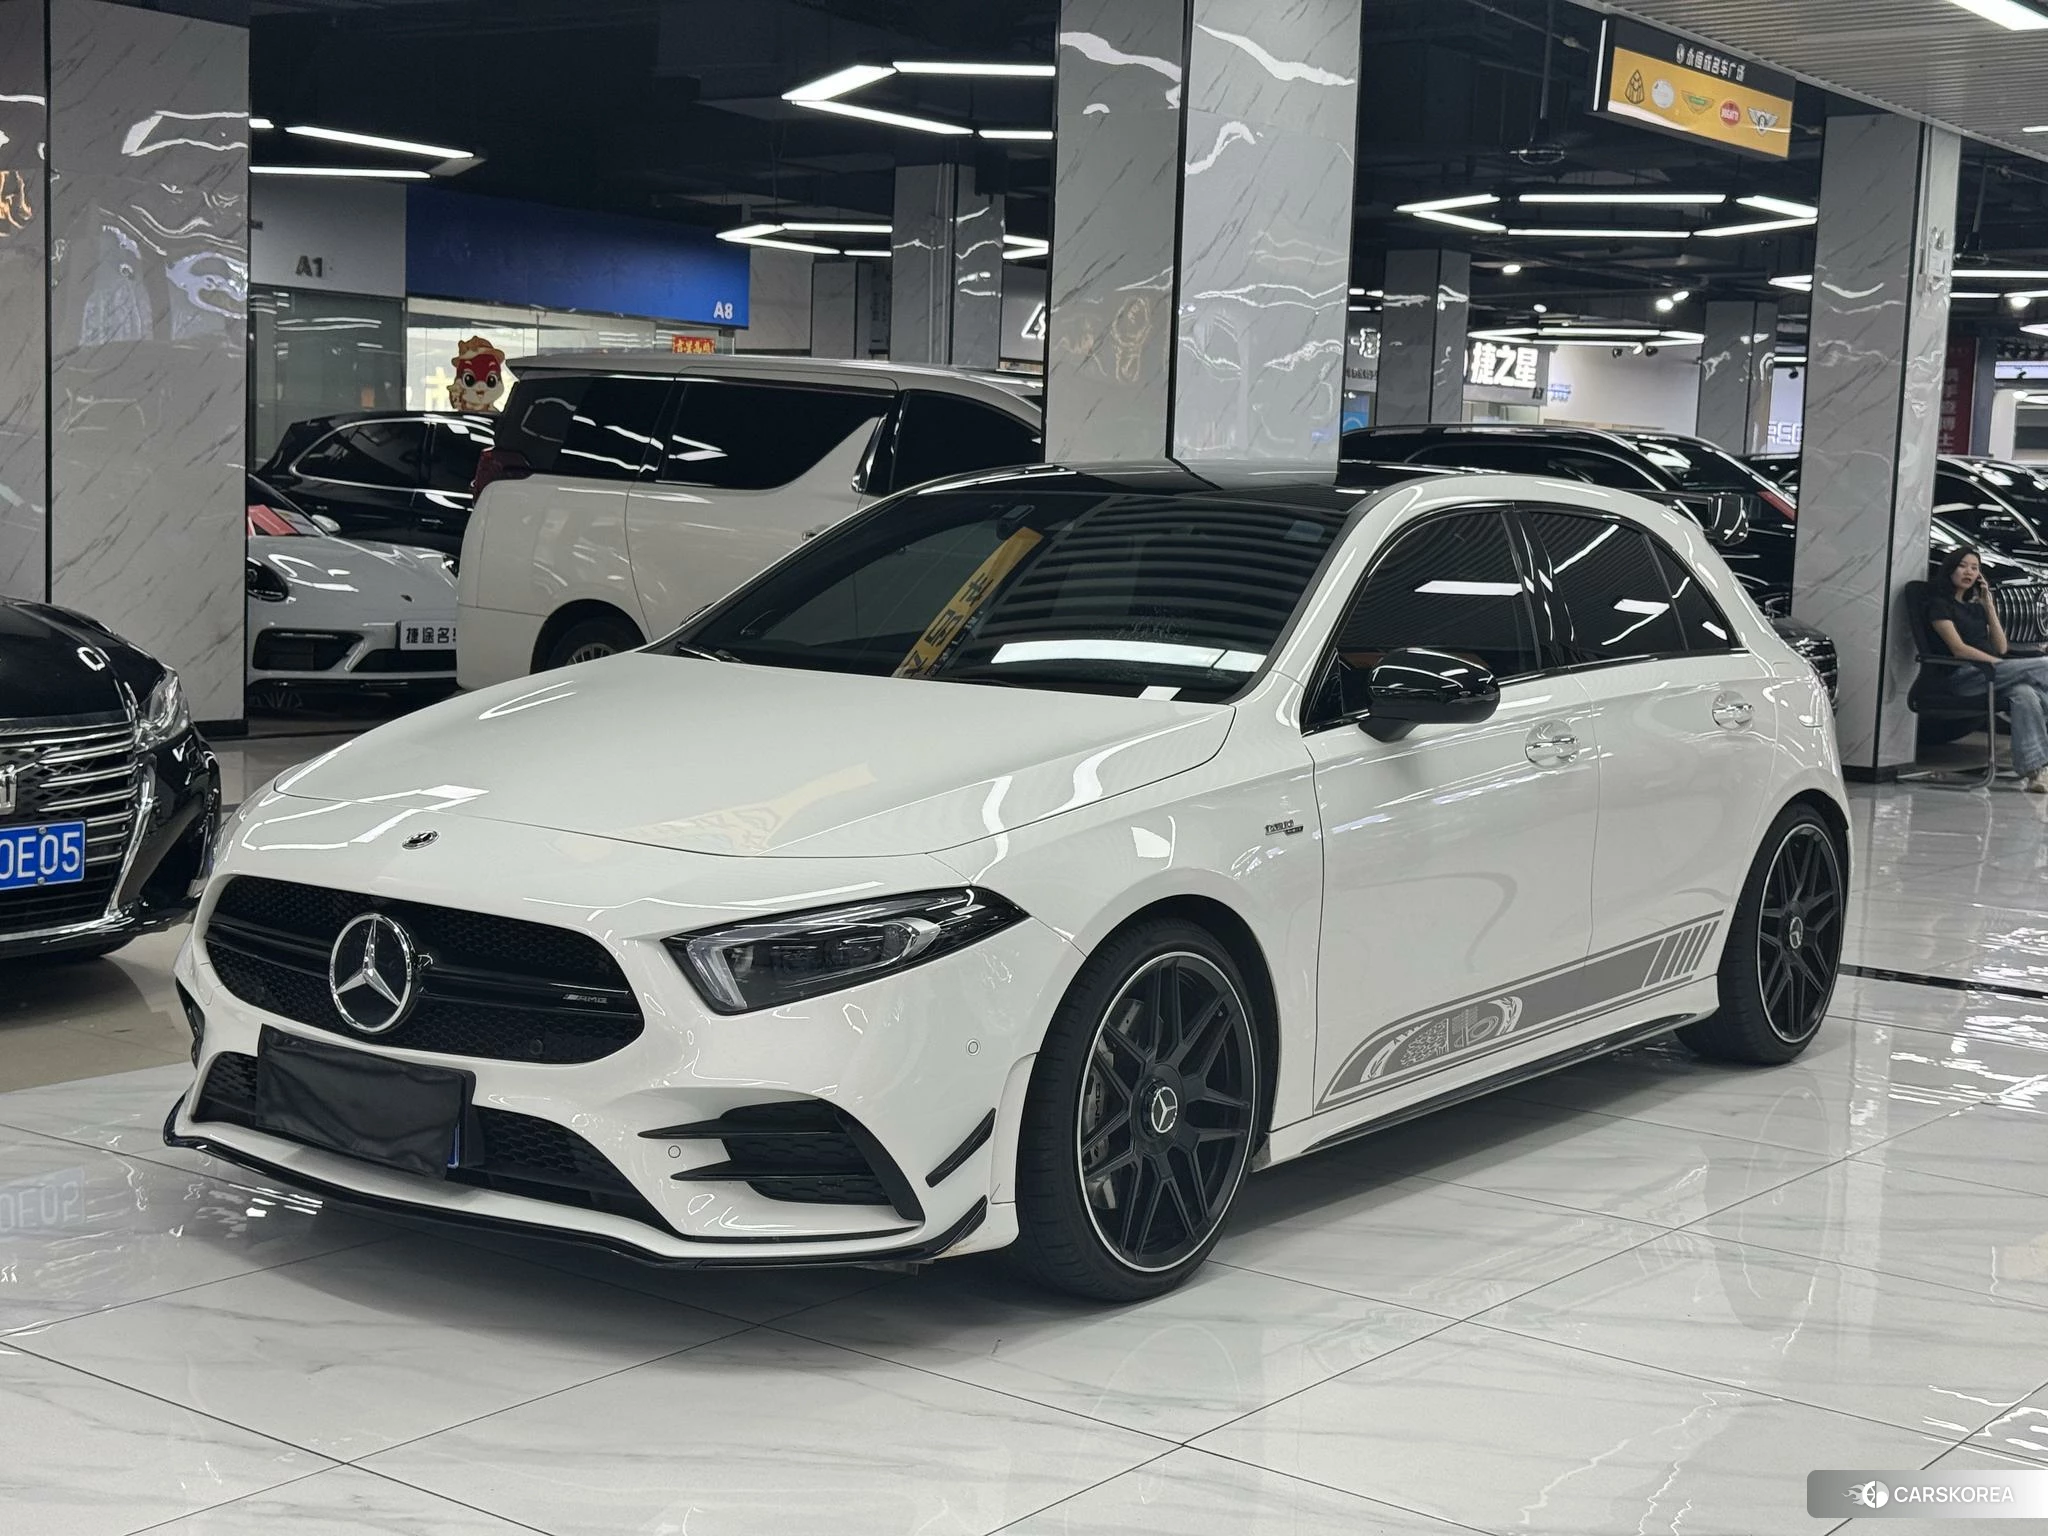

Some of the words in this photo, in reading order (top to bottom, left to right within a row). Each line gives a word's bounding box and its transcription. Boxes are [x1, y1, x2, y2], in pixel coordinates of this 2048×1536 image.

[295, 255, 323, 278] A1
[713, 301, 734, 320] A8
[1470, 341, 1539, 389] 捷之星
